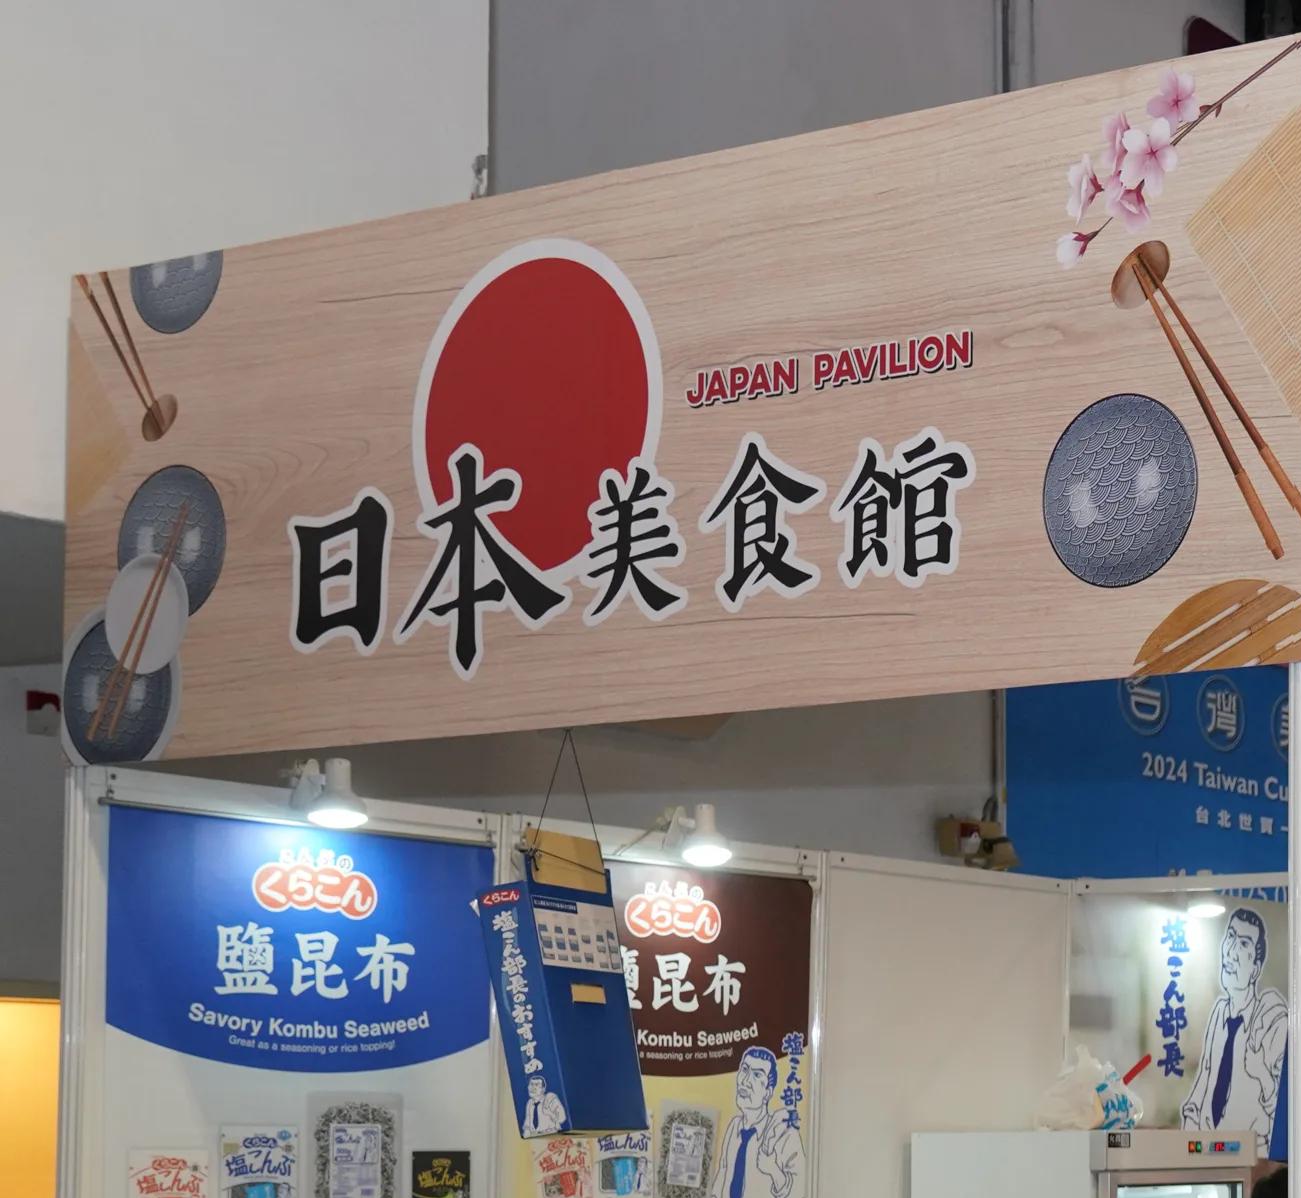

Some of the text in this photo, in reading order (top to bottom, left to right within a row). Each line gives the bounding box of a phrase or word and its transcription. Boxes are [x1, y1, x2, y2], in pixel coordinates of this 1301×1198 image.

[686, 331, 974, 408] JAPAN PAVILION
[293, 436, 969, 671] 日本美食館
[1141, 752, 1188, 784] 2024
[1193, 761, 1258, 796] Taiwan
[259, 868, 372, 913] くらこん
[482, 890, 520, 905] くらこん
[628, 901, 719, 940] くらこん
[212, 921, 416, 1004] 鹽昆布
[492, 910, 544, 1075] 塩こん部長のおすすめ
[1156, 916, 1190, 1078] 塩こん部長
[188, 1002, 430, 1039] Savory Kombu Seaweed
[636, 1022, 759, 1047] Kombu Seaweed
[228, 1035, 255, 1047] Great
[258, 1041, 269, 1049] as
[281, 1042, 326, 1055] seasoning
[340, 1043, 358, 1052] rice
[780, 1031, 805, 1131] 塩こん部長
[225, 1150, 296, 1177] 塩こんぶ
